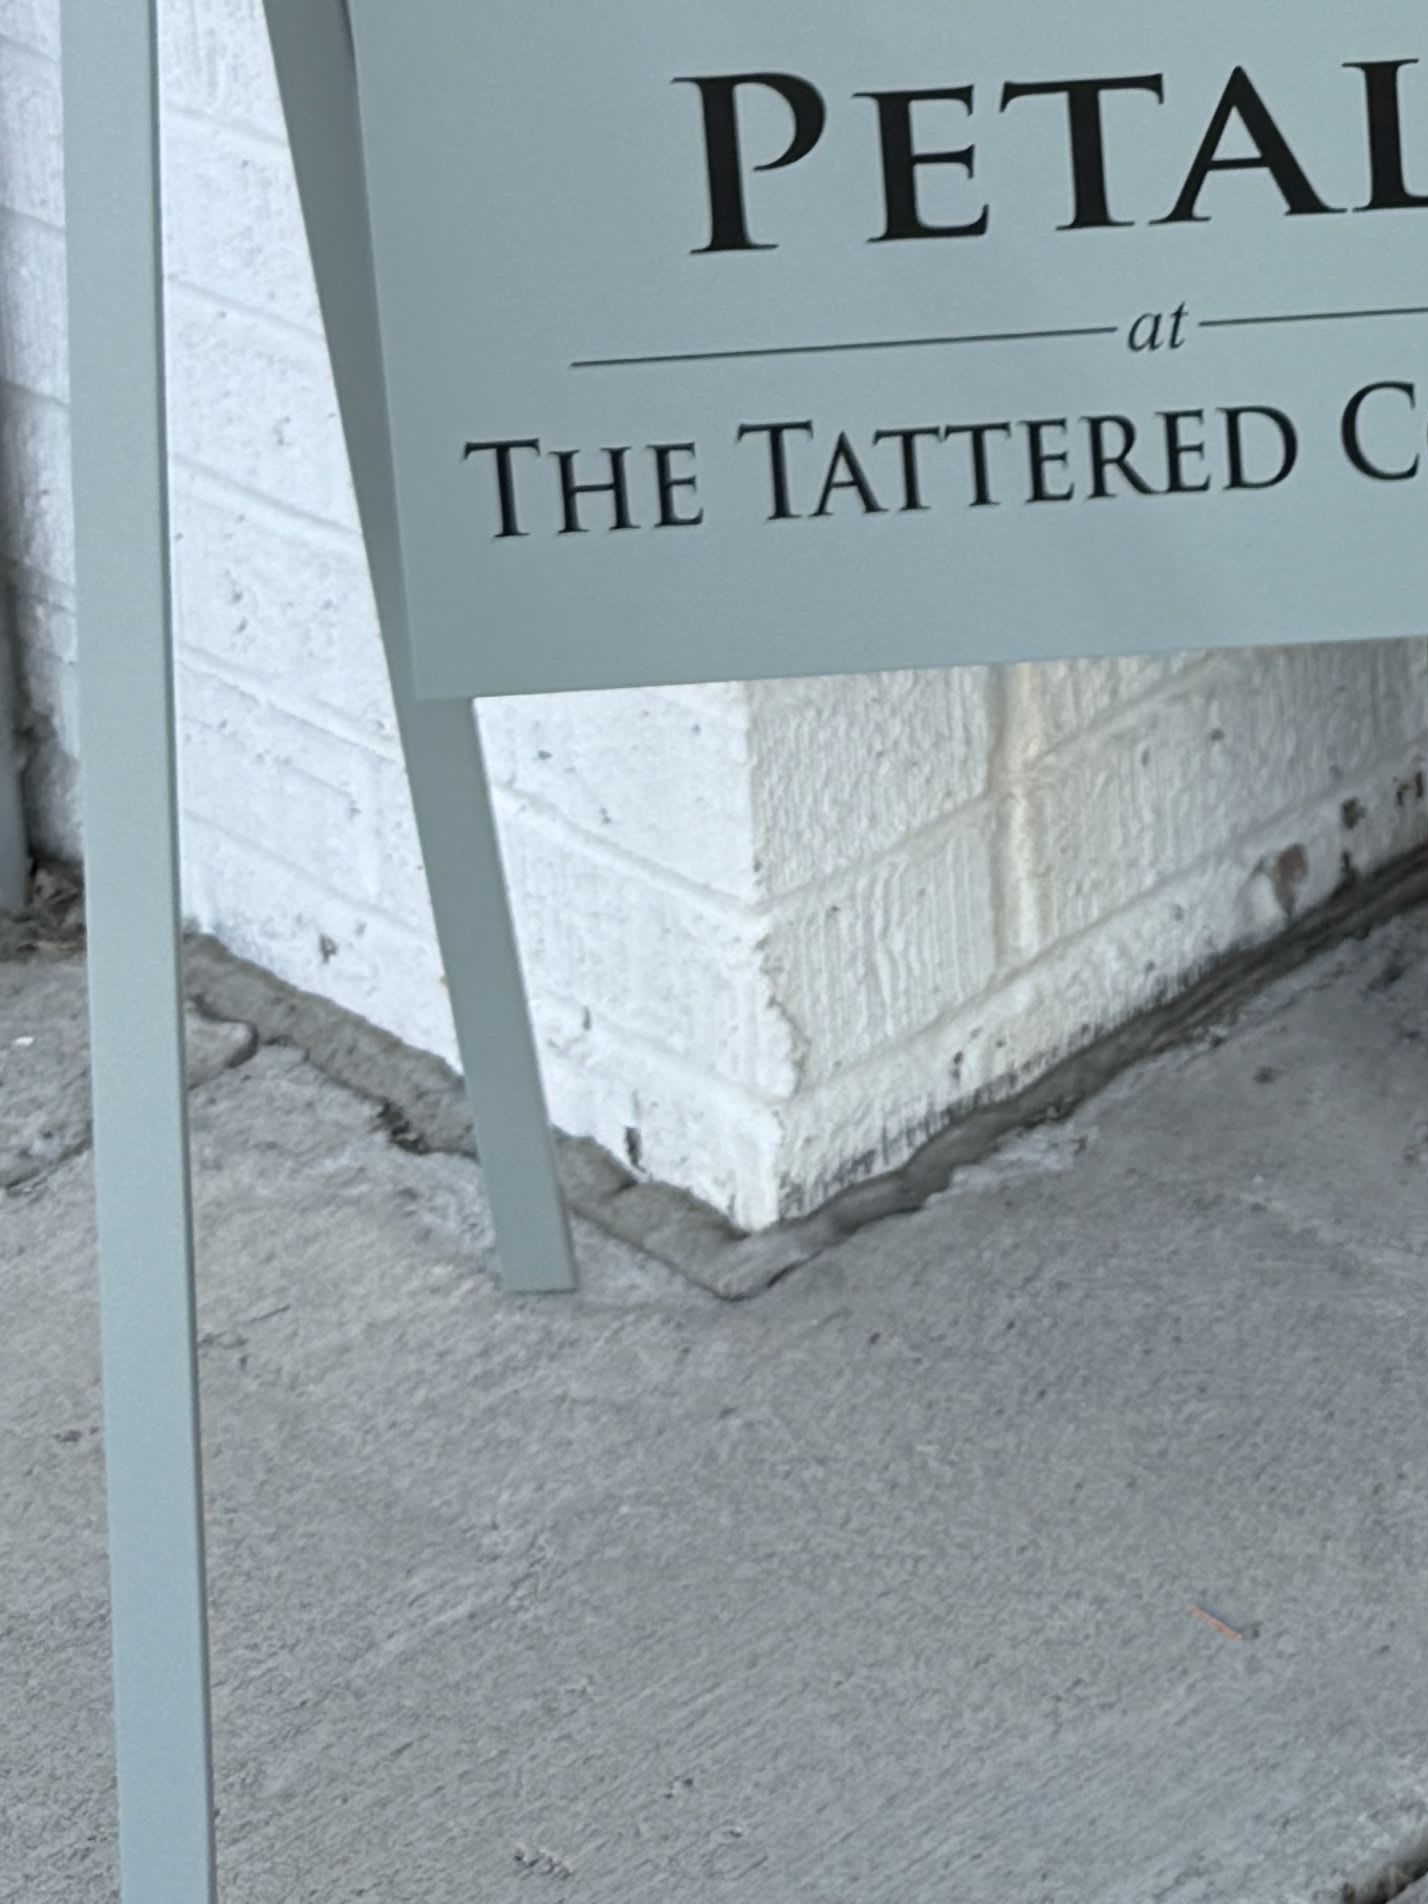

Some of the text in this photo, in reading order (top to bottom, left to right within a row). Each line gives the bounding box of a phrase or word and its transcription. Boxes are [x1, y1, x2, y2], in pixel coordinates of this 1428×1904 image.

[1126, 297, 1190, 354] at
[463, 437, 705, 540] THE
[737, 404, 1299, 522] TATTERED
